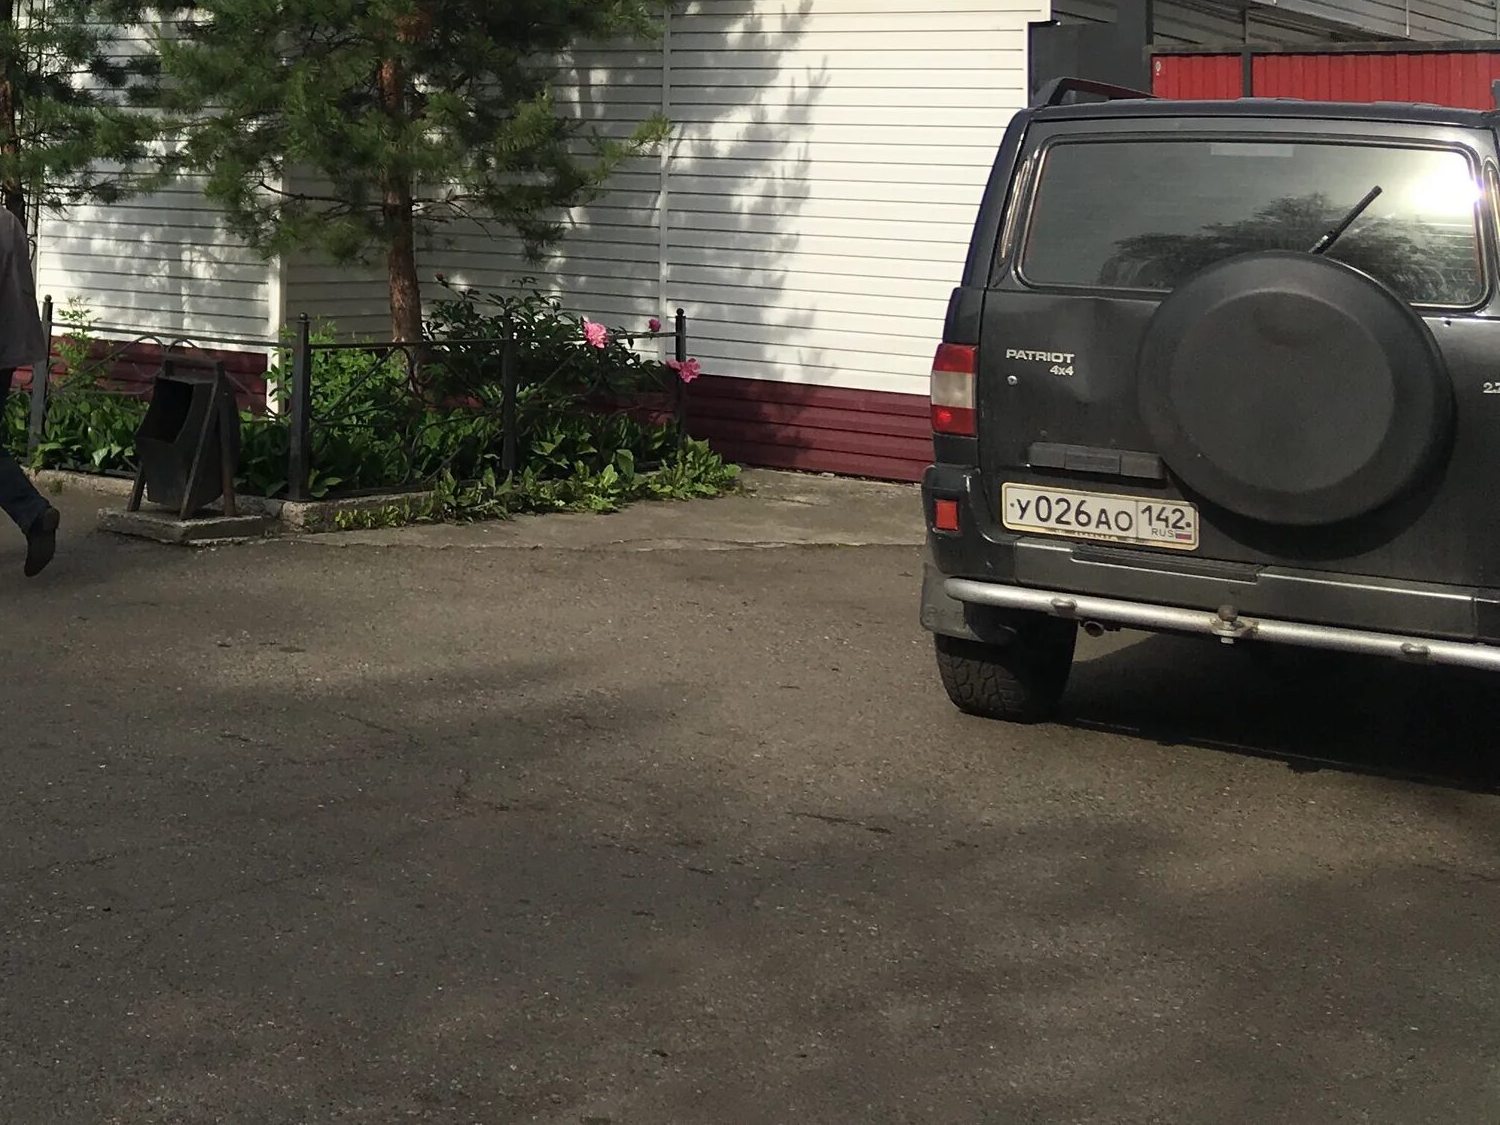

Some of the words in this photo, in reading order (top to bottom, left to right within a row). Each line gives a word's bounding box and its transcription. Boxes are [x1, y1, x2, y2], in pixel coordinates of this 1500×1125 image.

[1006, 348, 1075, 364] PATRIOT
[1049, 364, 1075, 376] 4x4
[1140, 505, 1187, 531] 142
[1151, 527, 1176, 539] RUS
